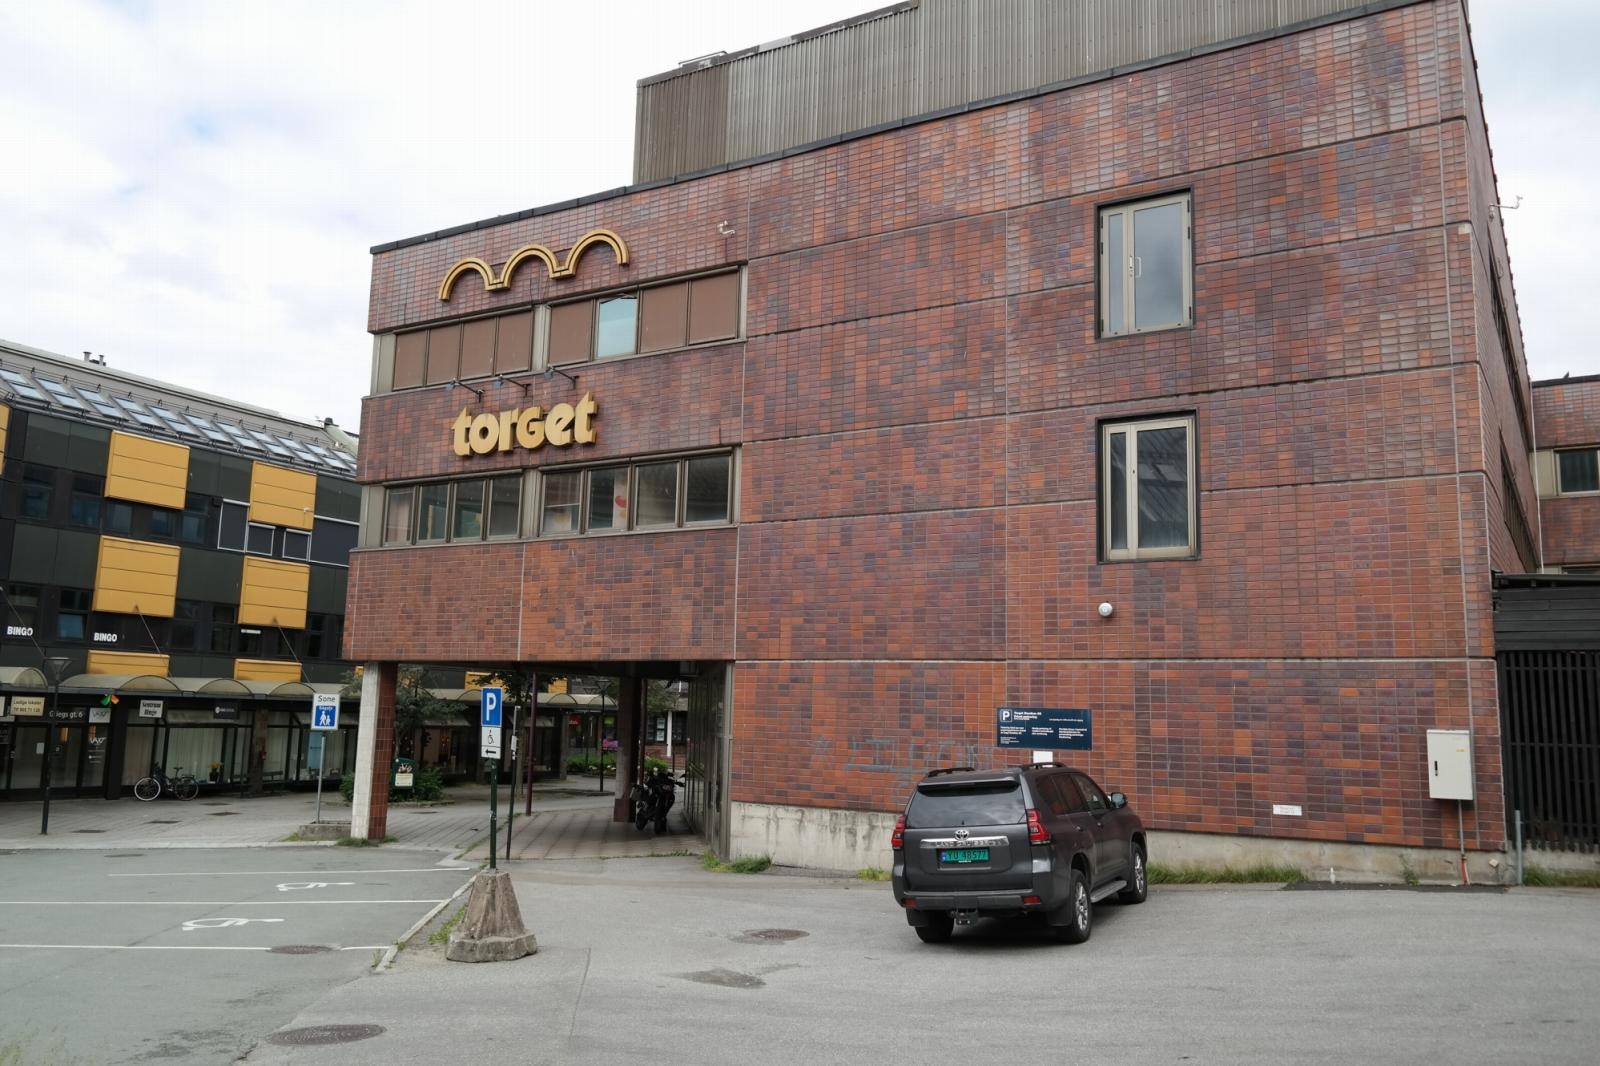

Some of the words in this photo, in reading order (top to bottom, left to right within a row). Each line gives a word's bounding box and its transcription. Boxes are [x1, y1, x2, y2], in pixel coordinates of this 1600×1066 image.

[7, 626, 34, 636] BINGO
[93, 632, 118, 642] BINGO
[318, 695, 336, 703] Sone
[486, 692, 497, 721] P
[1002, 711, 1010, 721] P
